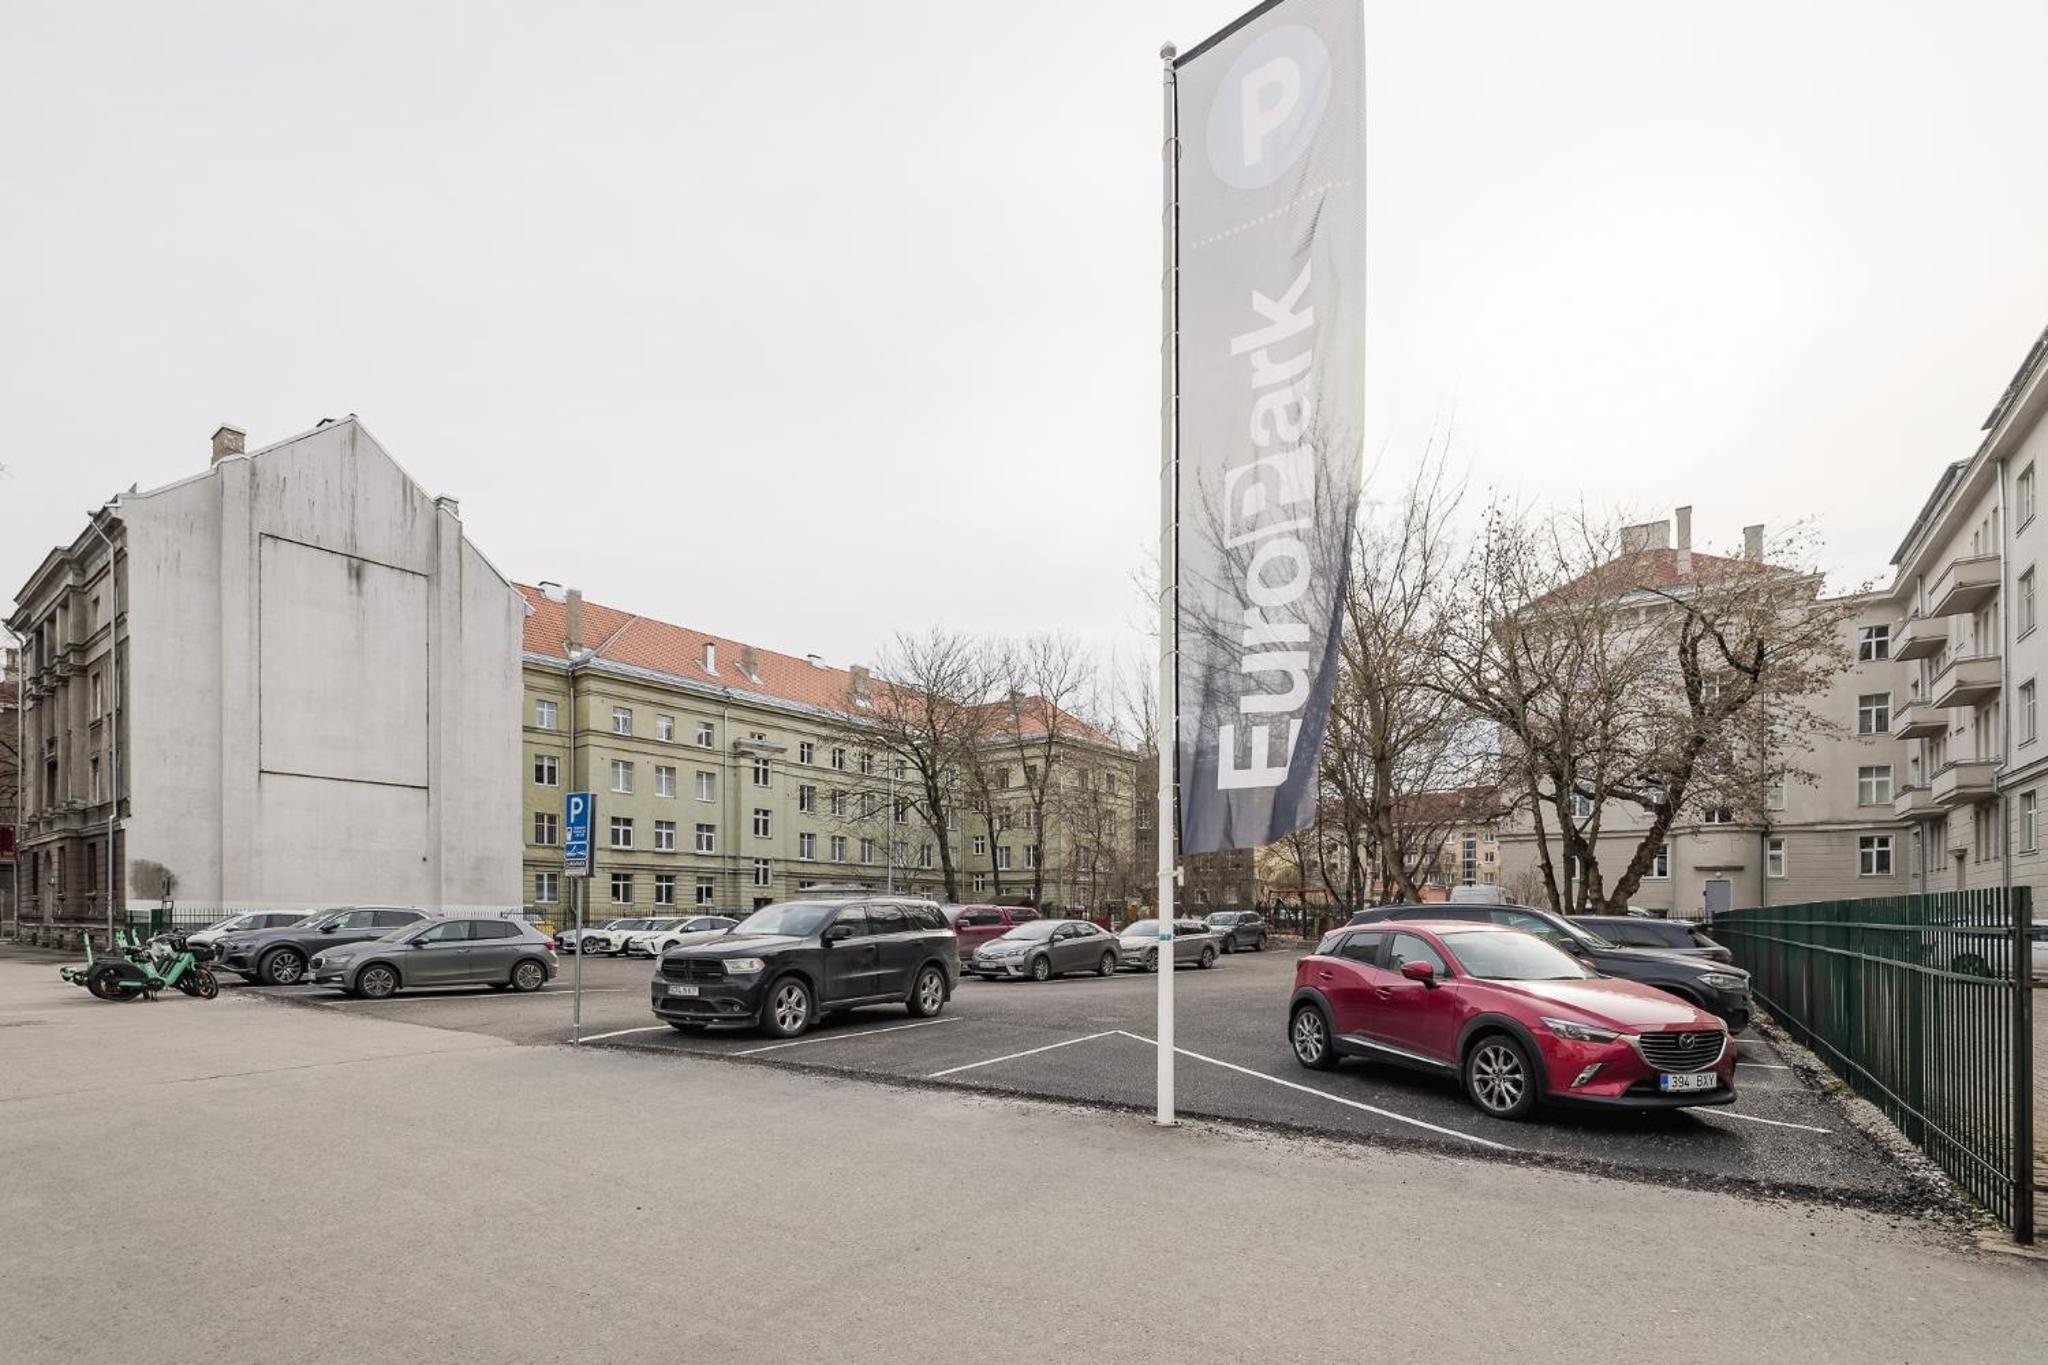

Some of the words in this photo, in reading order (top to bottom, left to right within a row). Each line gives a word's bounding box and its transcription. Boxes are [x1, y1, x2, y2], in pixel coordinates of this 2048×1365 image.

[1241, 57, 1300, 168] P
[1217, 258, 1316, 791] EuroPark
[570, 797, 584, 823] P
[1671, 1075, 1690, 1088] 394
[1696, 1074, 1715, 1087] BXY
